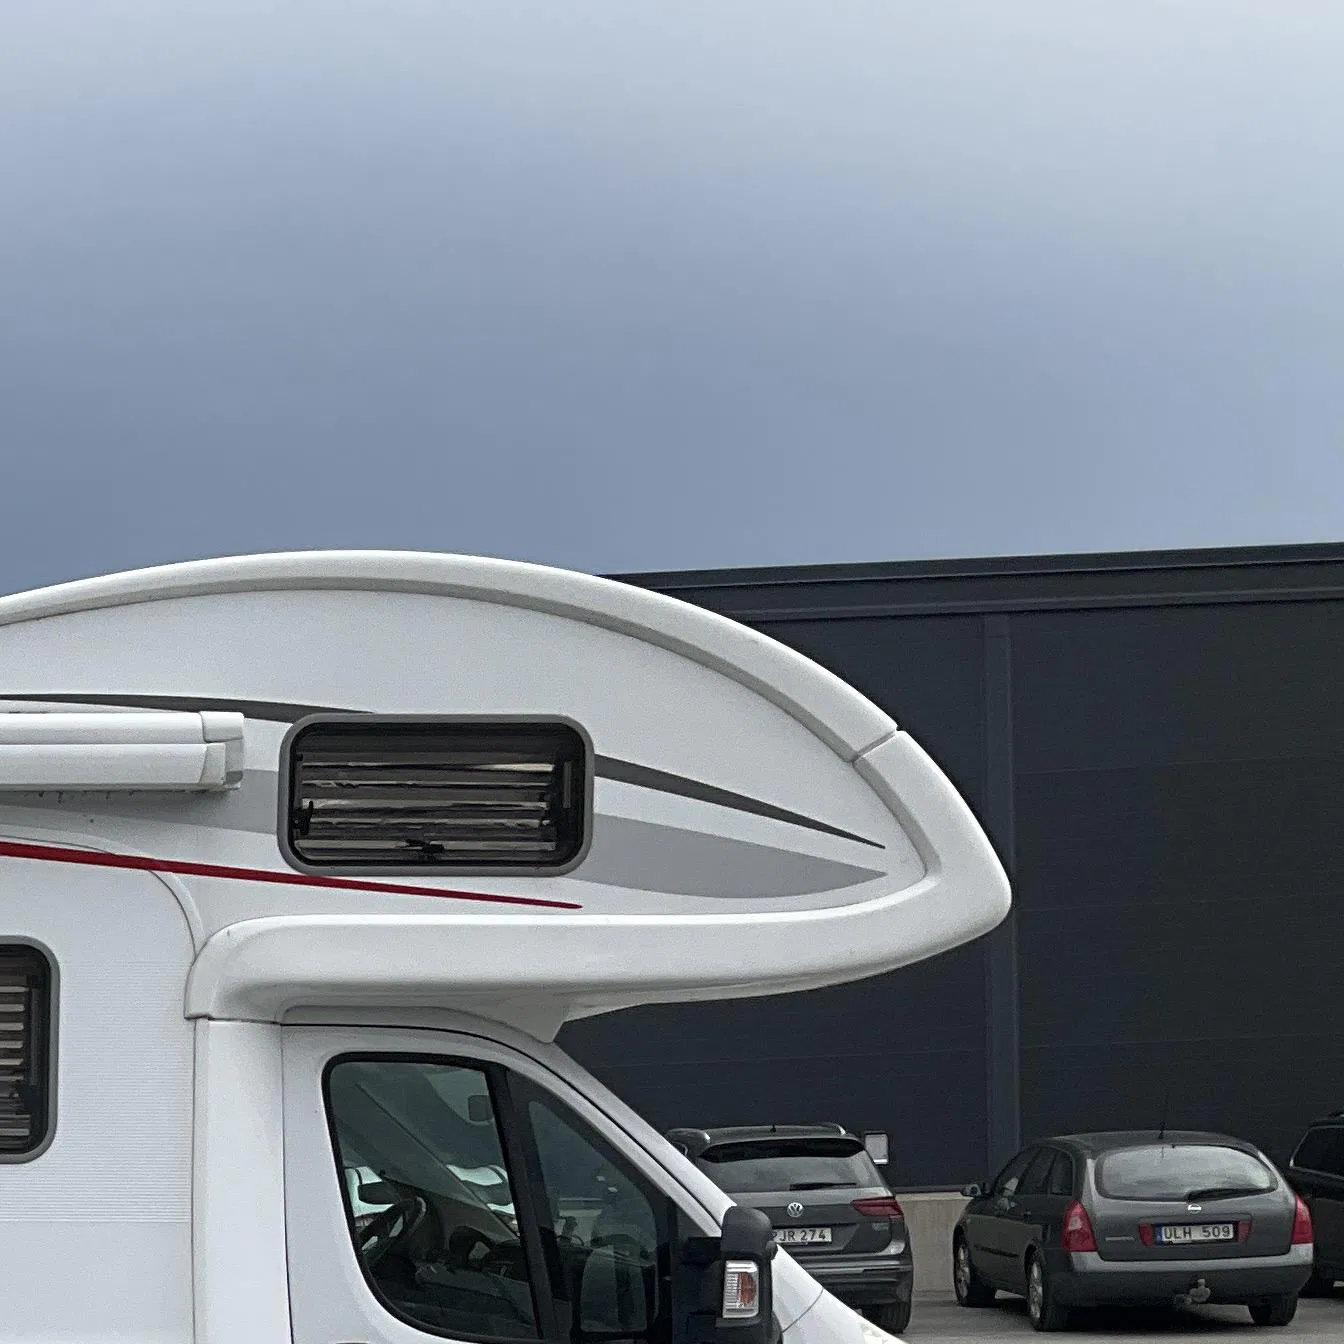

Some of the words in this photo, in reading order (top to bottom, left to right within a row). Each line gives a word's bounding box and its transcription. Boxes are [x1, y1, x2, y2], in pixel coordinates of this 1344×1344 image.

[800, 1229, 826, 1241] 274
[1164, 1226, 1192, 1240] ULH
[1202, 1224, 1230, 1238] 509
